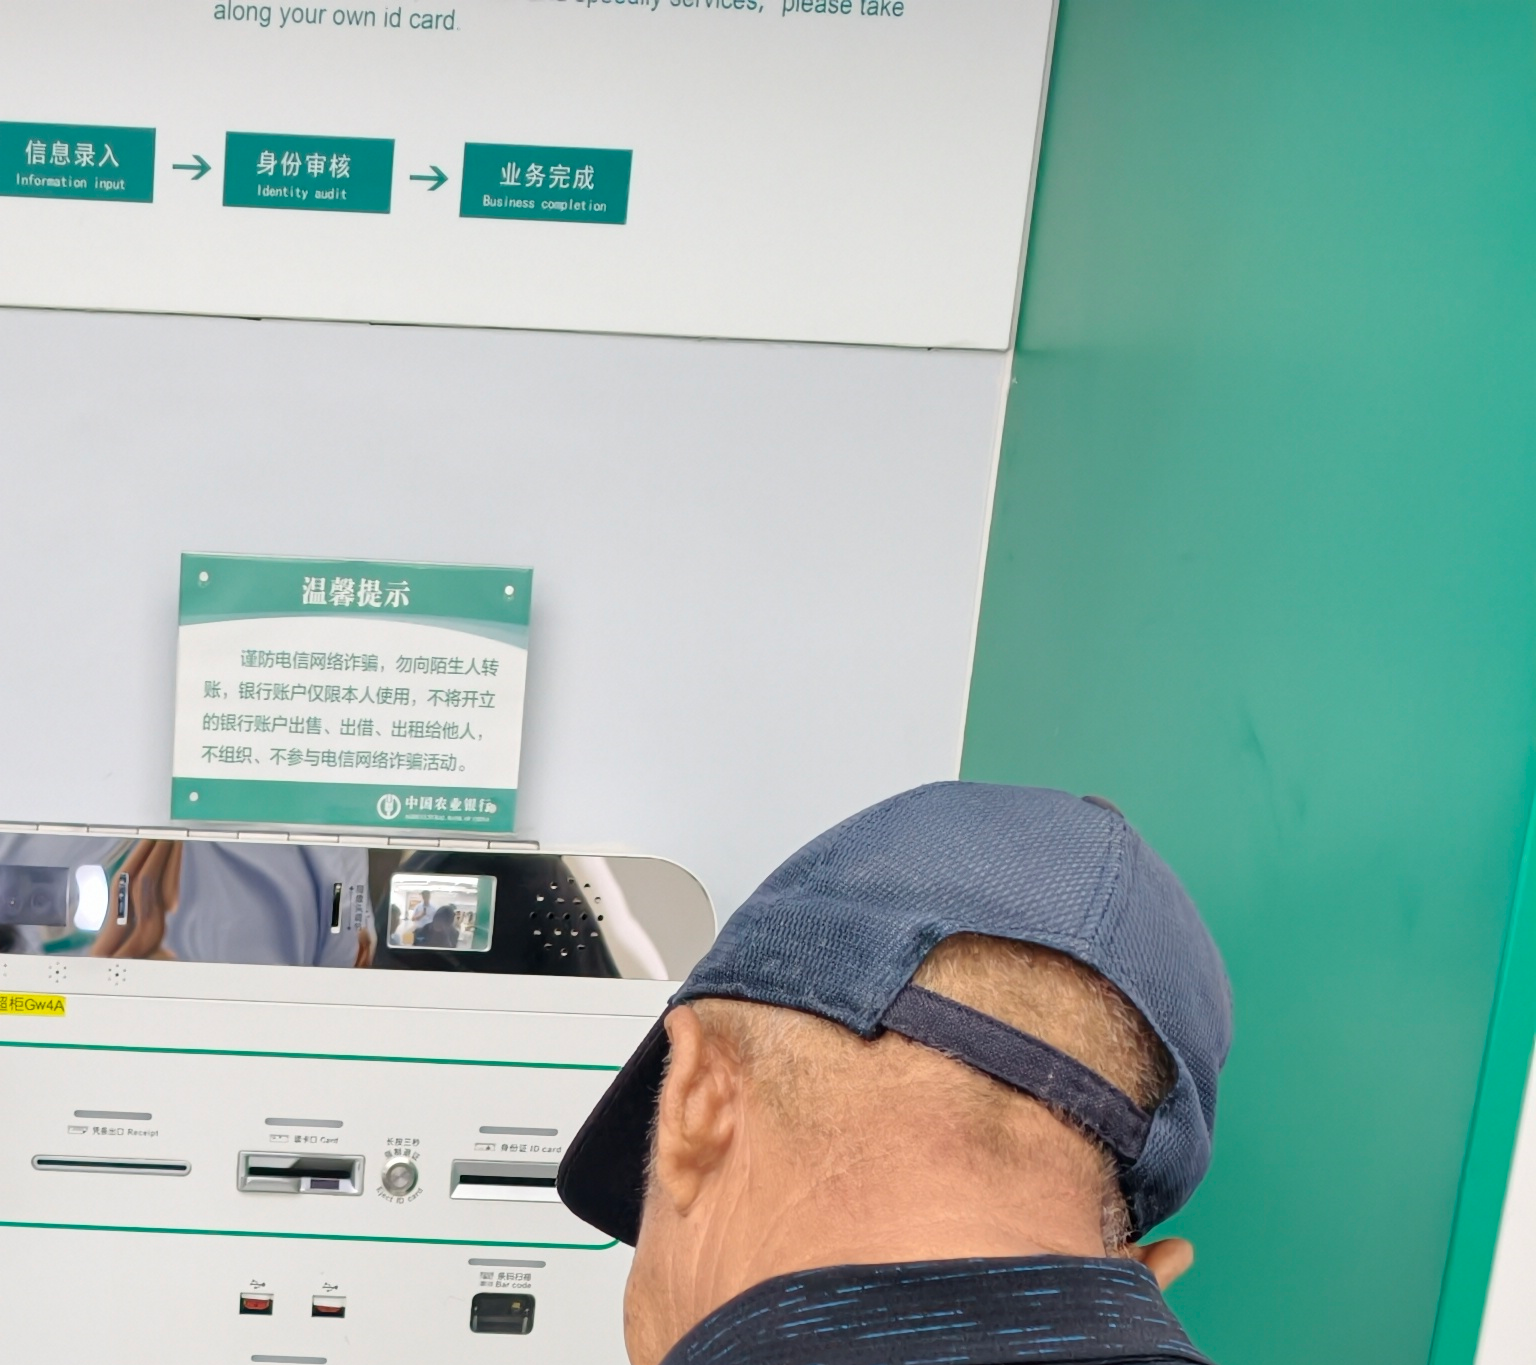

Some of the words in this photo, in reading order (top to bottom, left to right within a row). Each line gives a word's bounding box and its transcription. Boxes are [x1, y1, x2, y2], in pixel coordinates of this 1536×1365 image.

[213, 0, 271, 27] along
[279, 6, 327, 29] your
[332, 8, 375, 27] own
[383, 7, 402, 28] id
[781, 0, 852, 17] please
[860, 0, 904, 17] take
[25, 140, 120, 169] 信息录入
[256, 150, 352, 180] 身份审核
[15, 173, 88, 190] Information
[93, 175, 126, 192] input
[499, 161, 595, 190] 业务完成
[257, 184, 309, 201] Identity
[313, 186, 347, 201] audit
[482, 194, 535, 210] Business
[540, 196, 607, 214] completion
[301, 576, 411, 608] 温馨提示
[240, 649, 500, 676] 谨防电信网络诈骗，勿向陌生人转
[203, 680, 497, 709] 账，银行账户仅限本人使用，不将开立
[202, 713, 485, 742] 的银行账户出售、出借、出租给他人，
[200, 744, 467, 773] 不组织、不参与电信网络诈骗活动。
